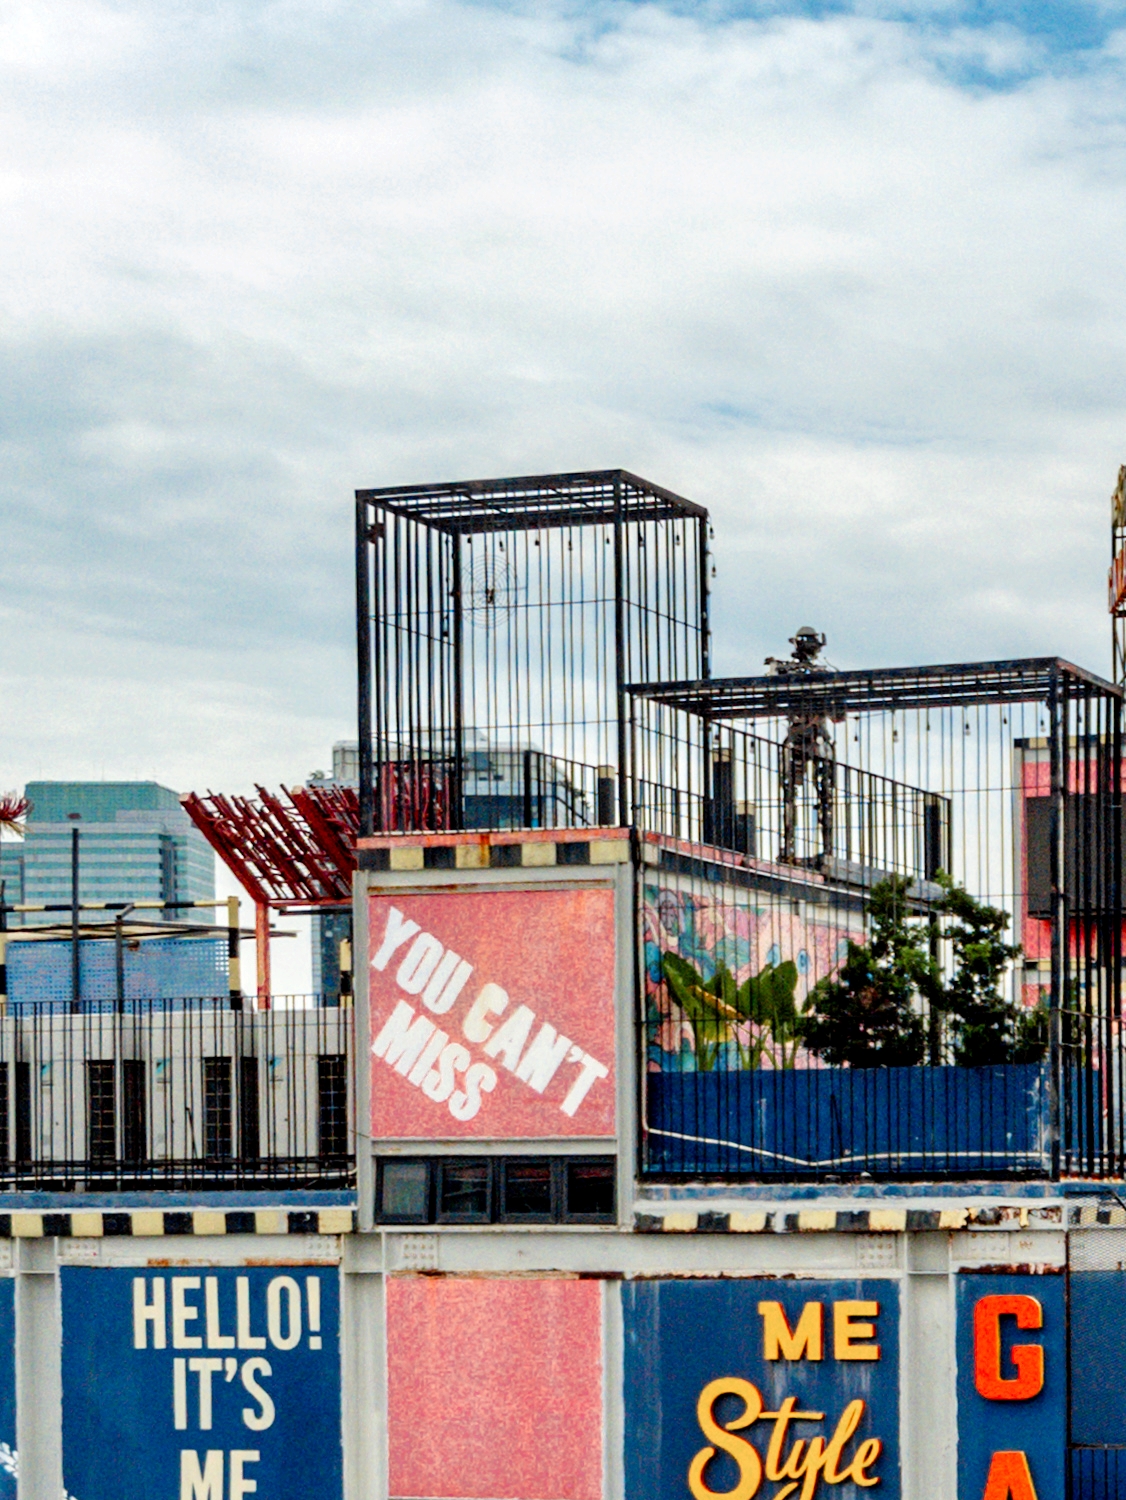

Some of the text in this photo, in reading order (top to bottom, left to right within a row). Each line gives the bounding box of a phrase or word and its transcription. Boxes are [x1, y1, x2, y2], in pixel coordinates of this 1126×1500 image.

[370, 906, 609, 1118] YOU CAN'T
[371, 999, 497, 1122] MISS
[133, 1275, 322, 1350] HELLO!
[758, 1300, 881, 1361] ME
[173, 1357, 276, 1431] IT'S
